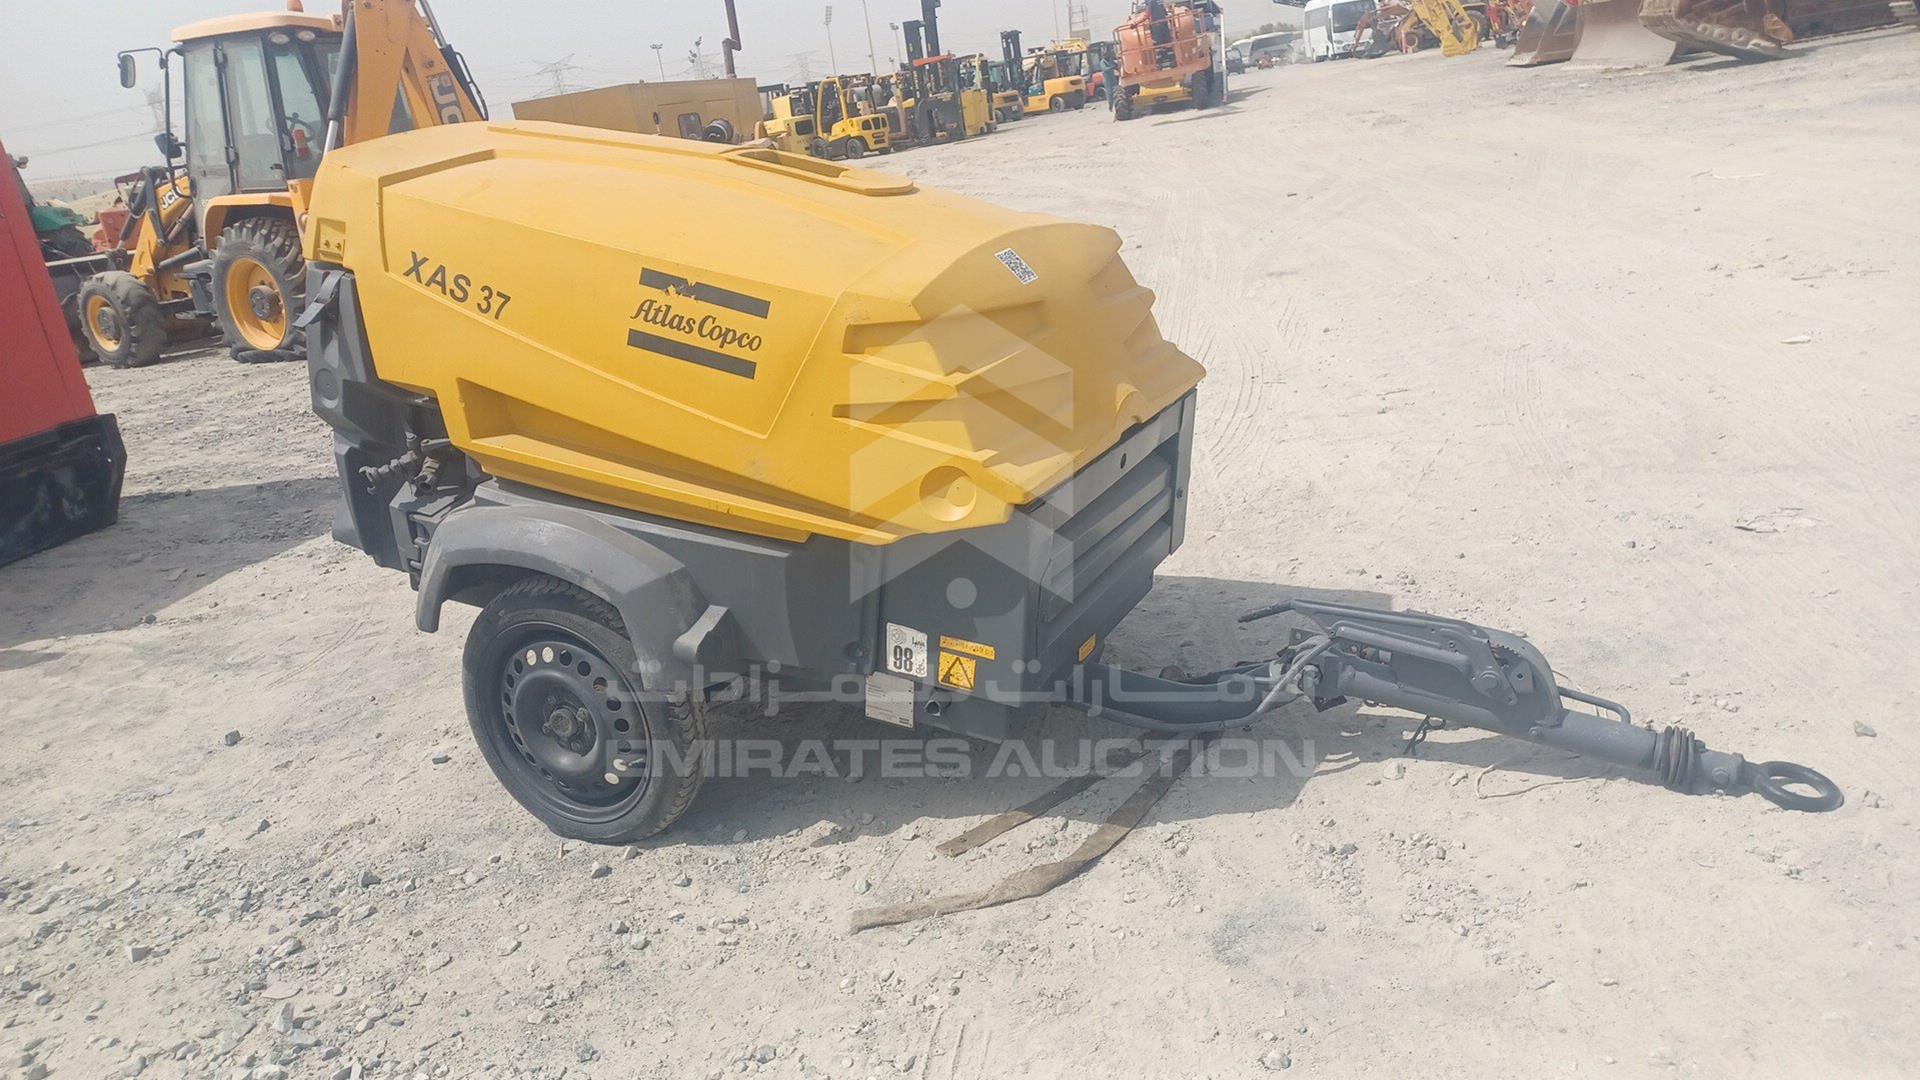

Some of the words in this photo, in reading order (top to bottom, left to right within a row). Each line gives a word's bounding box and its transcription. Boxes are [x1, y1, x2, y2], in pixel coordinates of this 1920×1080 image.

[430, 73, 464, 123] JC
[403, 251, 471, 303] XAS
[477, 285, 511, 320] 37
[630, 299, 696, 334] Atlas
[697, 314, 762, 351] Copco
[893, 645, 913, 672] 98
